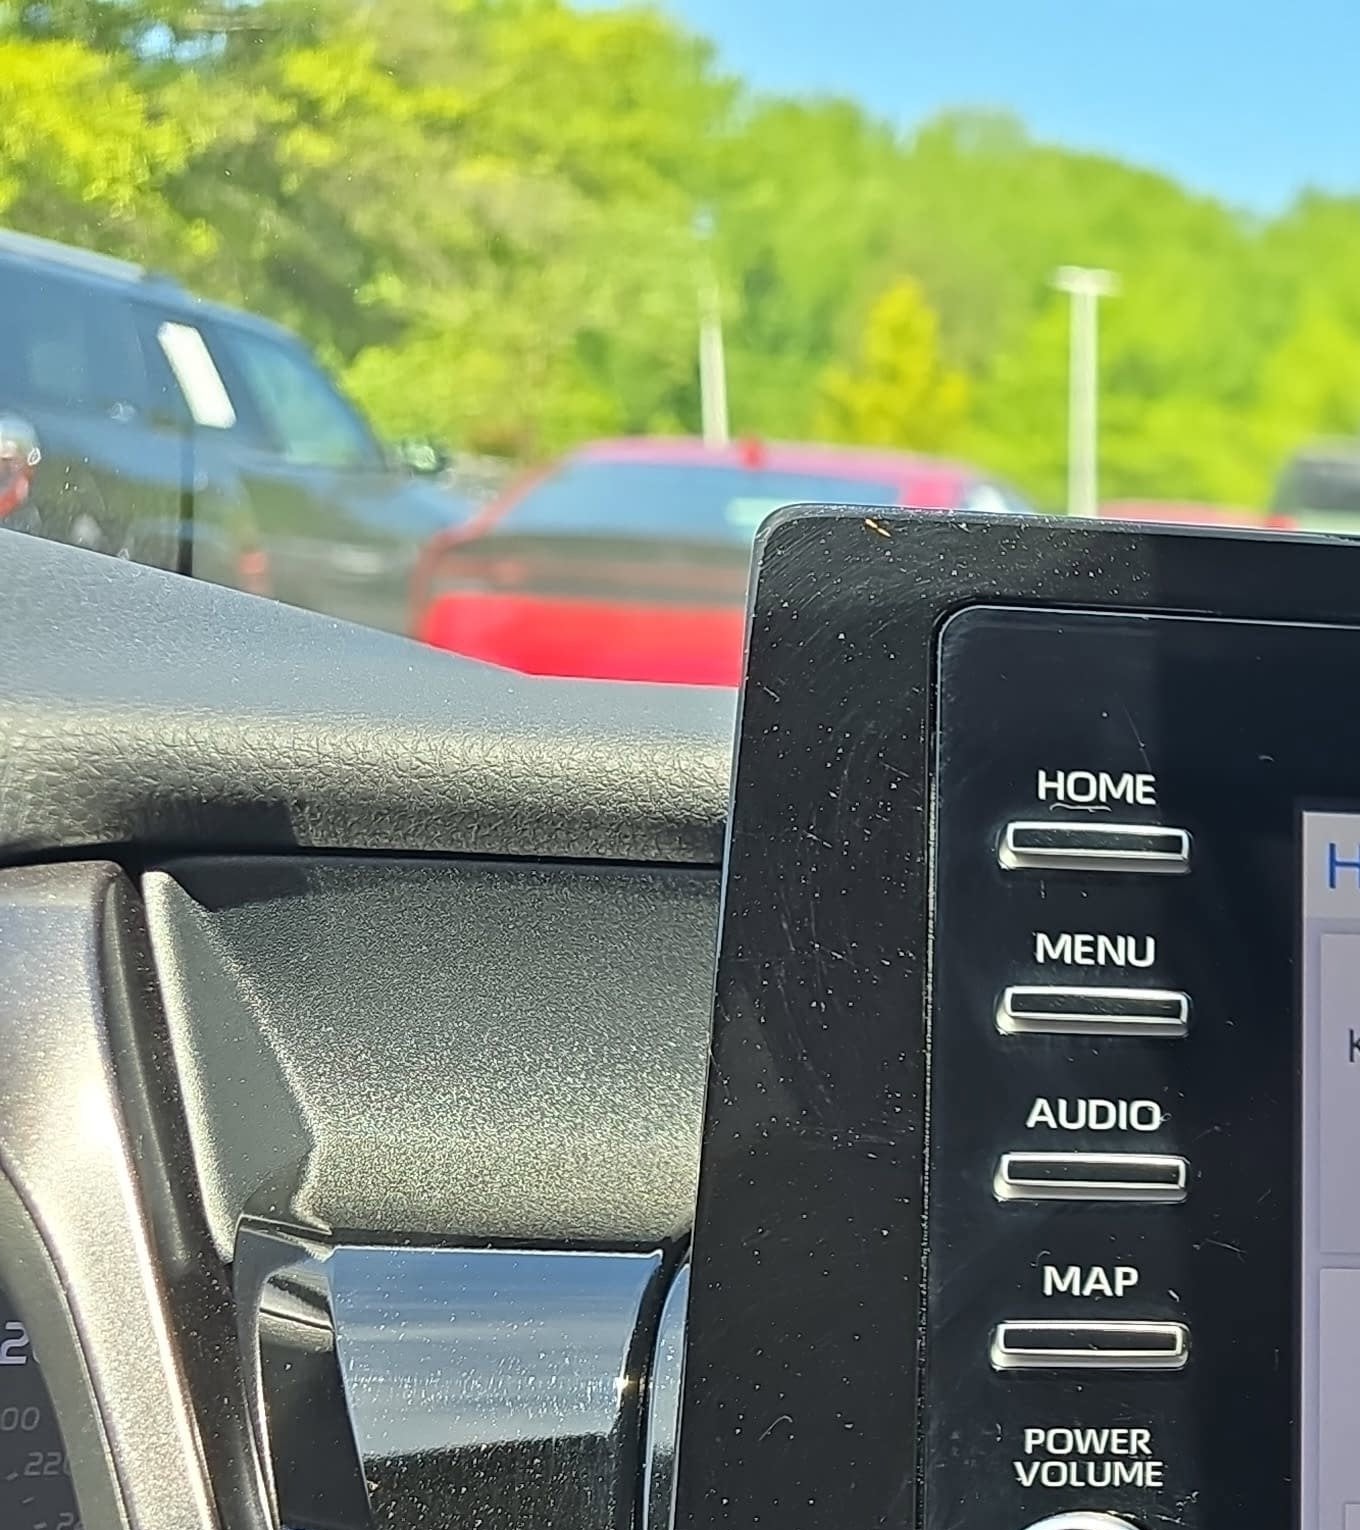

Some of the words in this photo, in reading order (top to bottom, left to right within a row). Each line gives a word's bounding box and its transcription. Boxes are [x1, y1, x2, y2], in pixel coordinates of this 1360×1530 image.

[1037, 770, 1157, 805] HOME
[1035, 933, 1156, 968] MENU
[1027, 1098, 1163, 1131] AUDIO
[1043, 1265, 1139, 1297] MAP
[0, 1321, 40, 1365] 2
[1024, 1428, 1151, 1455] POWER
[1015, 1461, 1163, 1487] VOLUME
